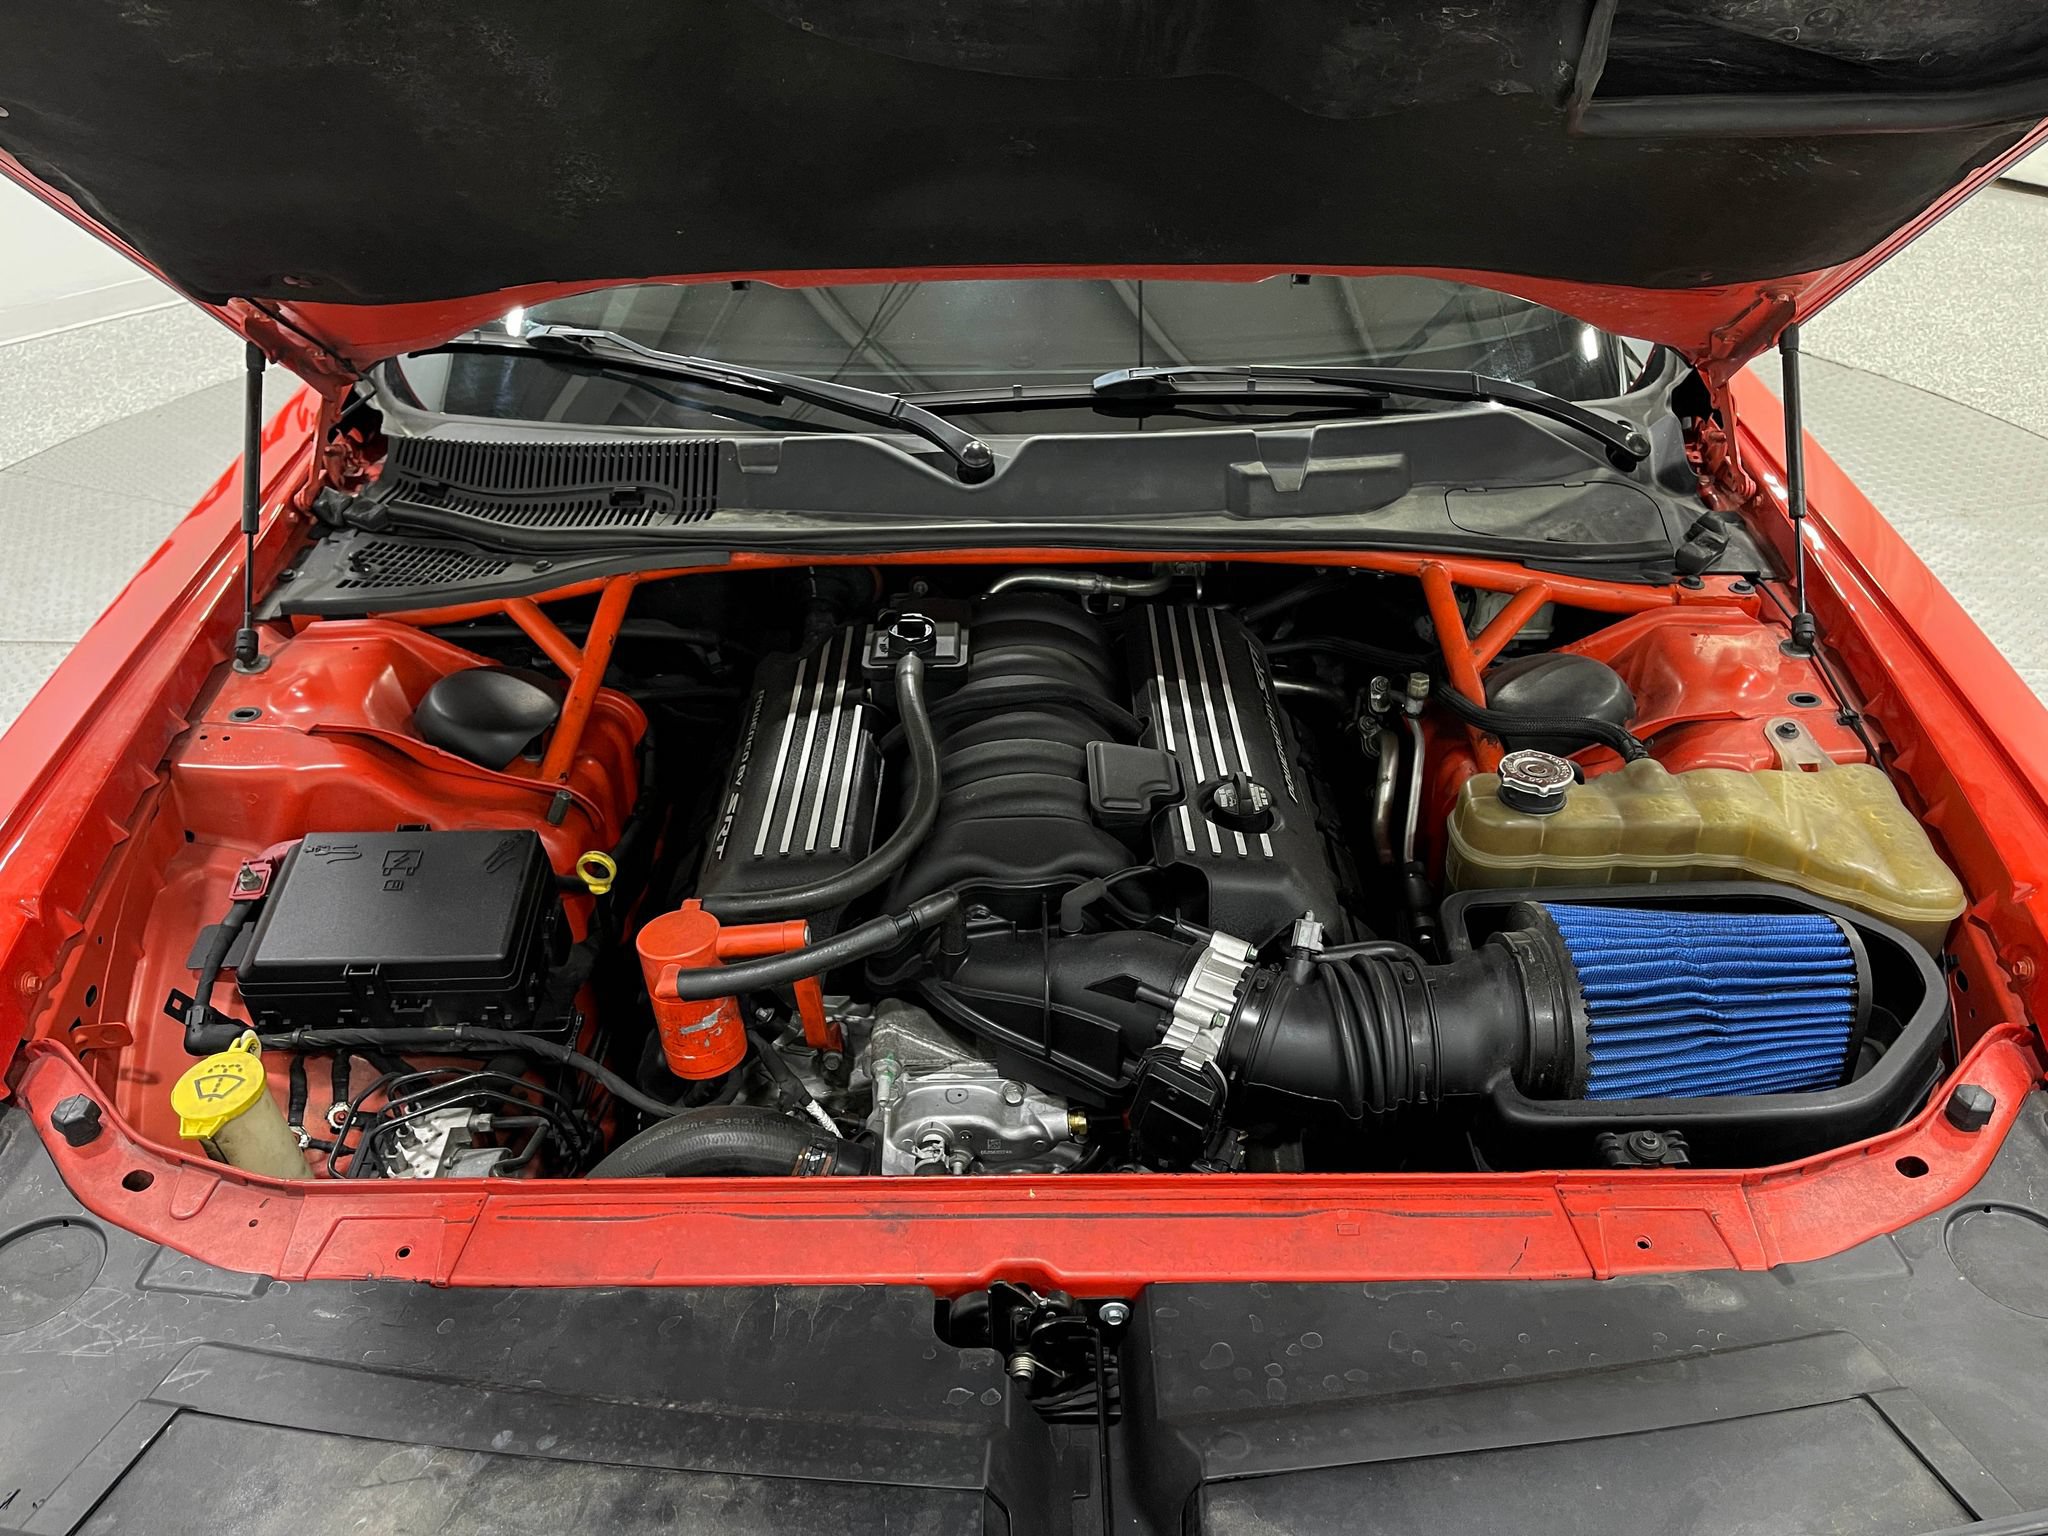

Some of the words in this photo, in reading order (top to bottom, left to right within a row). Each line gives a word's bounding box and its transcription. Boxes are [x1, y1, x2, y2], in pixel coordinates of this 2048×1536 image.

[1247, 638, 1271, 700] SRT
[741, 689, 766, 763] POWERED
[735, 764, 747, 786] BY
[715, 792, 740, 860] SRT
